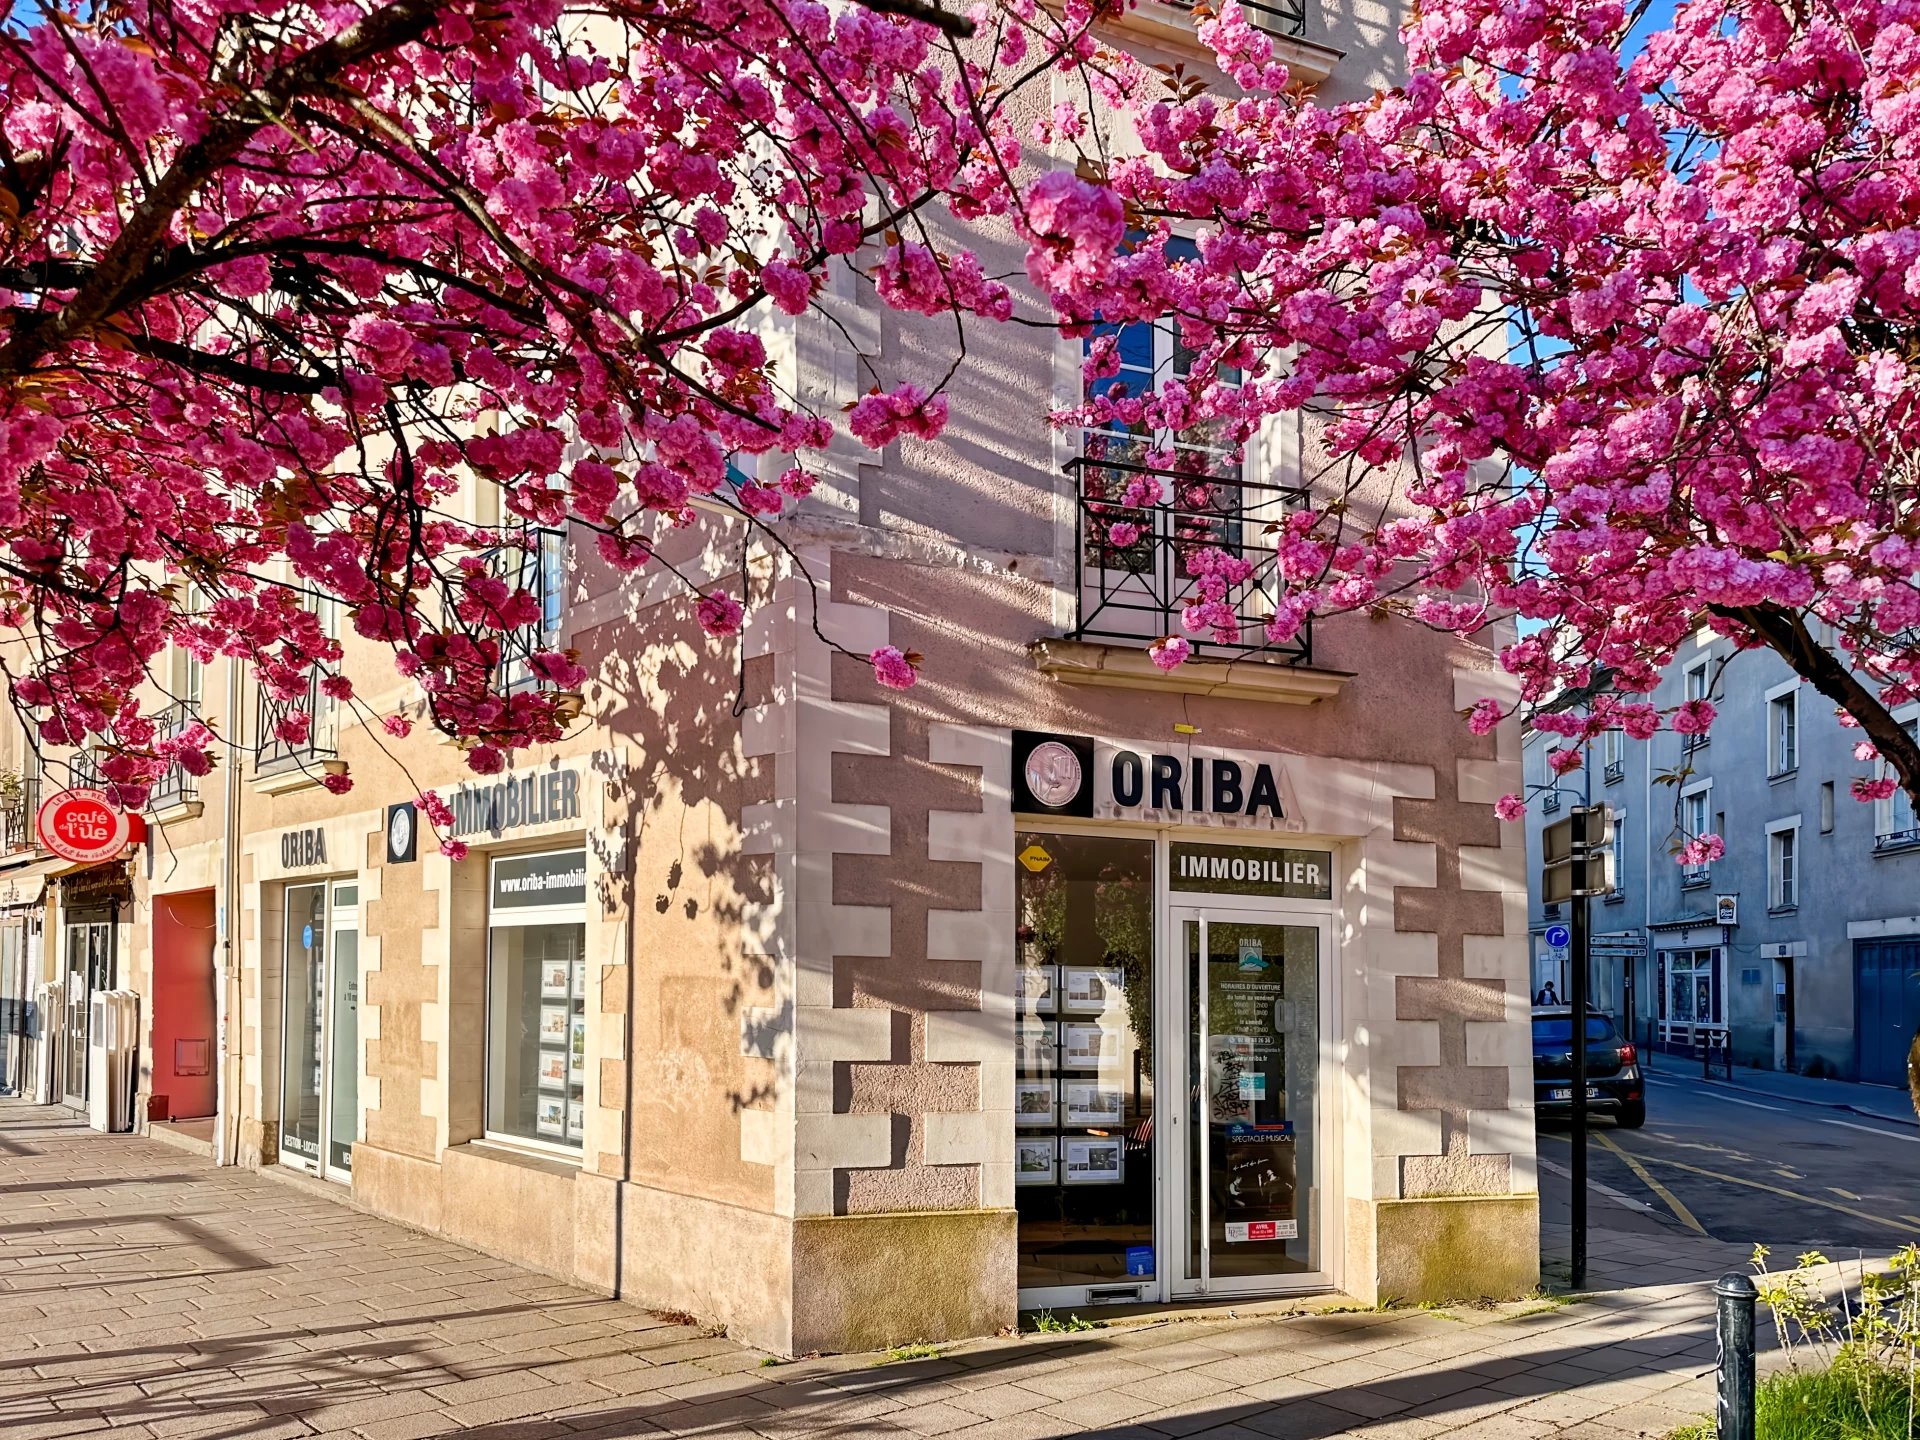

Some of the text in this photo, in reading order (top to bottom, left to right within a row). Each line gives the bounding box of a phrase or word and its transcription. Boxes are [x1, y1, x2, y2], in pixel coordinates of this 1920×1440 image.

[1112, 750, 1284, 818] ORIBA
[450, 769, 581, 837] IMMOBILIER
[66, 811, 108, 824] café
[281, 827, 327, 869] ORIBA
[1180, 855, 1320, 885] IMMOBILIER
[1239, 938, 1262, 947] ORIBA
[284, 1134, 302, 1150] GESTION
[1231, 1134, 1292, 1143] SPECTACLE MUSICAL
